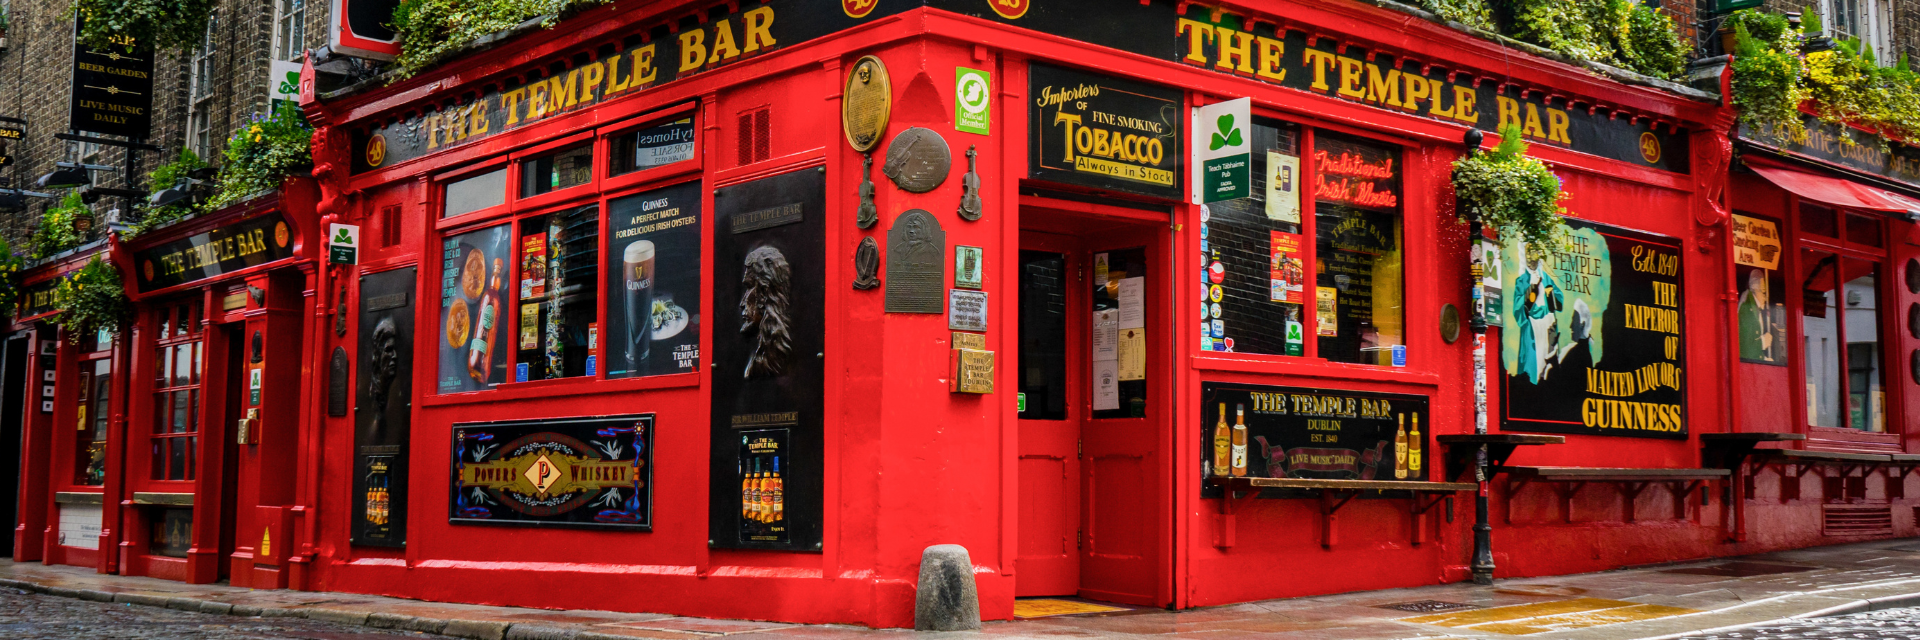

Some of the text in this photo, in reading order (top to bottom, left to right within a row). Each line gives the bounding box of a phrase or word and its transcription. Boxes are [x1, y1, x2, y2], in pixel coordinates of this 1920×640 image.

[108, 34, 136, 46] AR
[79, 62, 148, 78] BEER GARDEN
[423, 5, 776, 150] THE TEMPLE BAR
[1178, 17, 1572, 145] THE TEMPLE BAR
[80, 100, 144, 115] LIVE MUSIC
[1037, 83, 1100, 111] Importers
[1077, 102, 1088, 110] OF
[94, 113, 128, 124] DAILY
[962, 118, 984, 128] Member
[964, 112, 983, 120] Official
[1093, 111, 1162, 134] FINE SMOKING
[0, 129, 20, 138] BAR
[368, 138, 383, 162] 48
[1642, 137, 1656, 157] 48
[1078, 158, 1171, 183] Always in Stock
[1315, 150, 1393, 178] Traditional
[1315, 174, 1397, 207] Irish Music
[642, 198, 668, 211] GUINNESS
[732, 204, 802, 226] THE TEMPLE BAR
[616, 216, 696, 238] FOR DELICIOUS IRISH OYSTERS
[636, 212, 660, 224] PERFECT
[660, 208, 679, 218] MATCH
[1332, 218, 1386, 246] TEMPLE BAR
[161, 228, 266, 276] THE TEMPLE BAR
[1565, 234, 1590, 256] THE
[1738, 249, 1754, 263] Area
[1552, 252, 1602, 277] TEMPLE
[1658, 253, 1678, 277] 1840
[627, 278, 650, 290] GUINNESS
[1564, 272, 1591, 296] BAR
[1652, 280, 1678, 308] THE
[1624, 304, 1679, 334] EMPEROR
[672, 350, 699, 360] TEMPLE
[1664, 336, 1678, 360] OF
[679, 360, 692, 368] BAR
[1586, 362, 1682, 396] MALTED LIQUORS
[1250, 392, 1392, 420] THE TEMPLE BAR
[1582, 398, 1682, 432] GUINNESS
[1308, 420, 1341, 431] DUBLIN
[1311, 434, 1338, 443] EST. 1840
[1290, 454, 1356, 466] LIVE MUSIC DAILY
[474, 467, 516, 482] POWERS
[538, 461, 550, 487] P
[570, 464, 626, 482] WHISKEY
